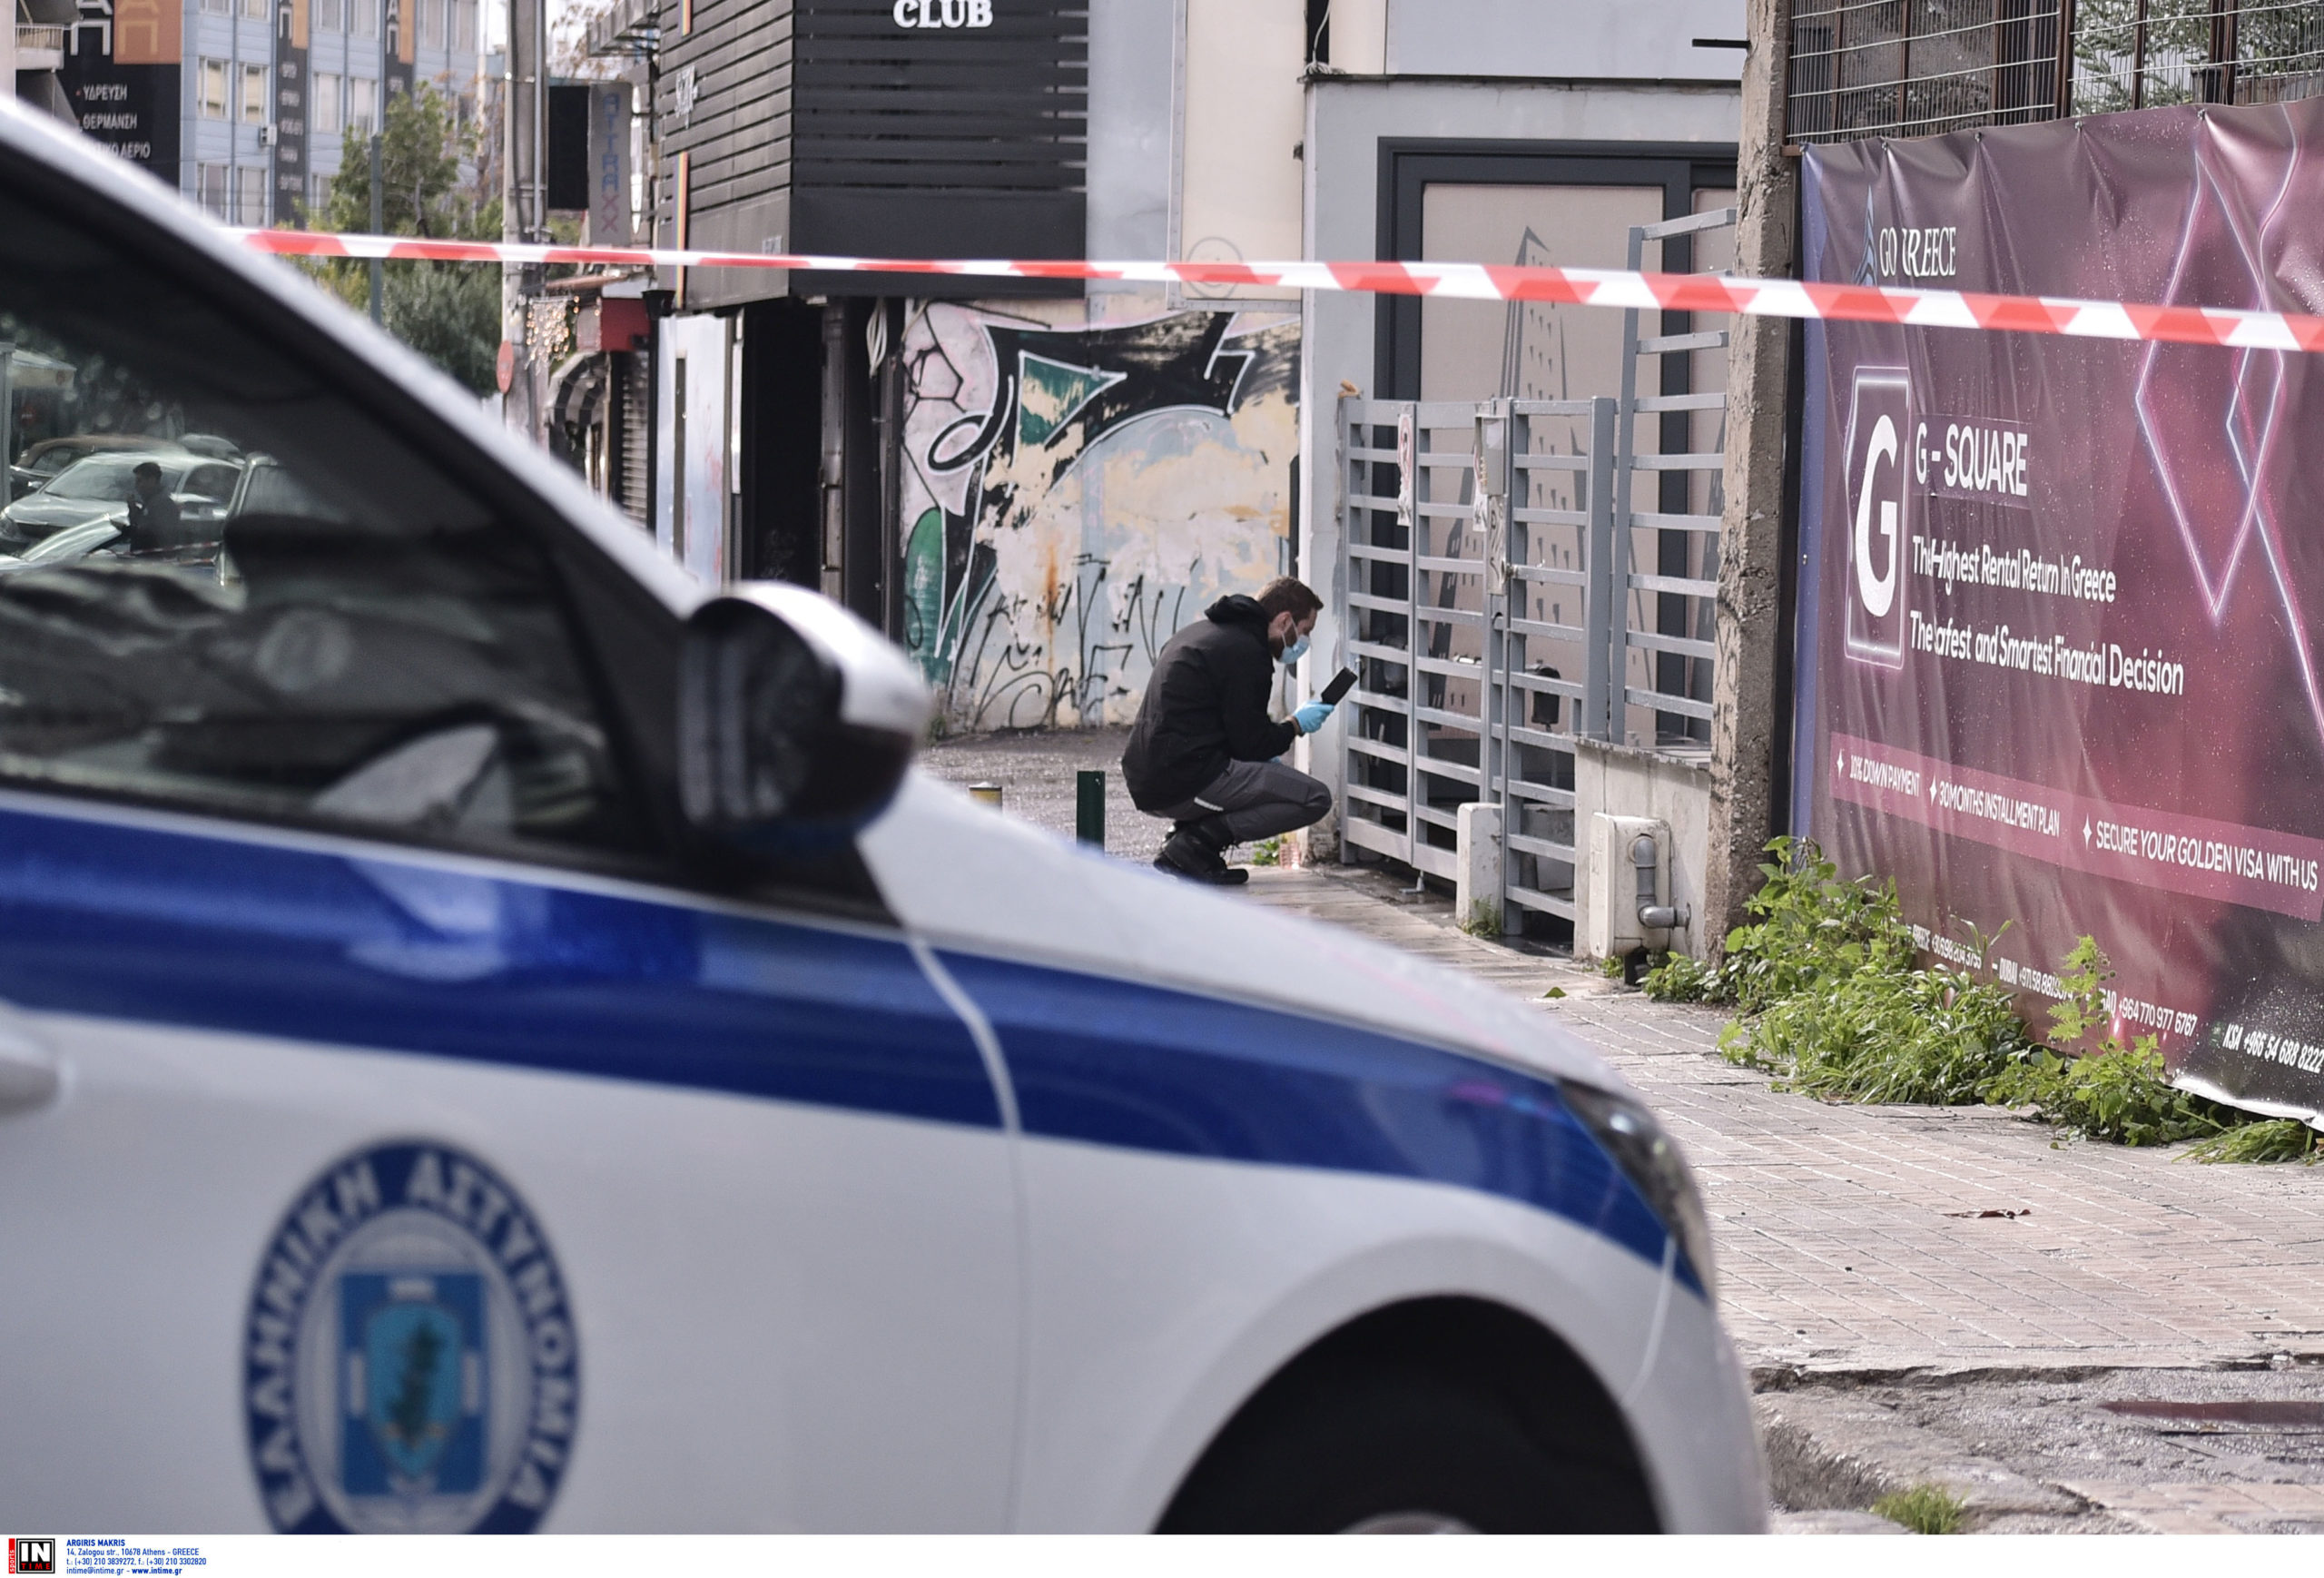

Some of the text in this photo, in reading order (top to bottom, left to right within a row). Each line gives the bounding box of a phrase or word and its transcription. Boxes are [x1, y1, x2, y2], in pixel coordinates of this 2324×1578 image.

[893, 0, 993, 28] CLUB
[84, 84, 127, 101] ΥΔΡΕΥΣΗ
[83, 113, 137, 129] ΘΕΡΜΑΝΣΗ
[1879, 227, 1897, 277] GO
[1856, 415, 1897, 616] G
[1930, 538, 1981, 597] Highest
[1981, 544, 2021, 589] Rental
[2022, 549, 2059, 595] Return
[2072, 554, 2117, 603] Greece
[1910, 610, 2184, 695] The afest and Smartest Financial Decision
[1863, 758, 1888, 788] DOWN
[1888, 764, 1920, 797] PAYMENT
[1951, 784, 1984, 817] MONTHS
[1984, 792, 2040, 832] INSTALLMENT
[2038, 806, 2060, 837] PLAN
[2096, 820, 2318, 892] SECURE YOUR GOLDEN VISA WITH US
[1999, 957, 2018, 985] DUBAI
[2119, 997, 2139, 1021] +964
[2140, 1001, 2155, 1026] 770
[2156, 1006, 2174, 1031] 977
[2175, 1011, 2198, 1037] 6767
[2222, 1023, 2243, 1050] KSA
[2243, 1031, 2266, 1057] +966
[2264, 1035, 2281, 1060] 54
[2279, 1039, 2299, 1067] 688
